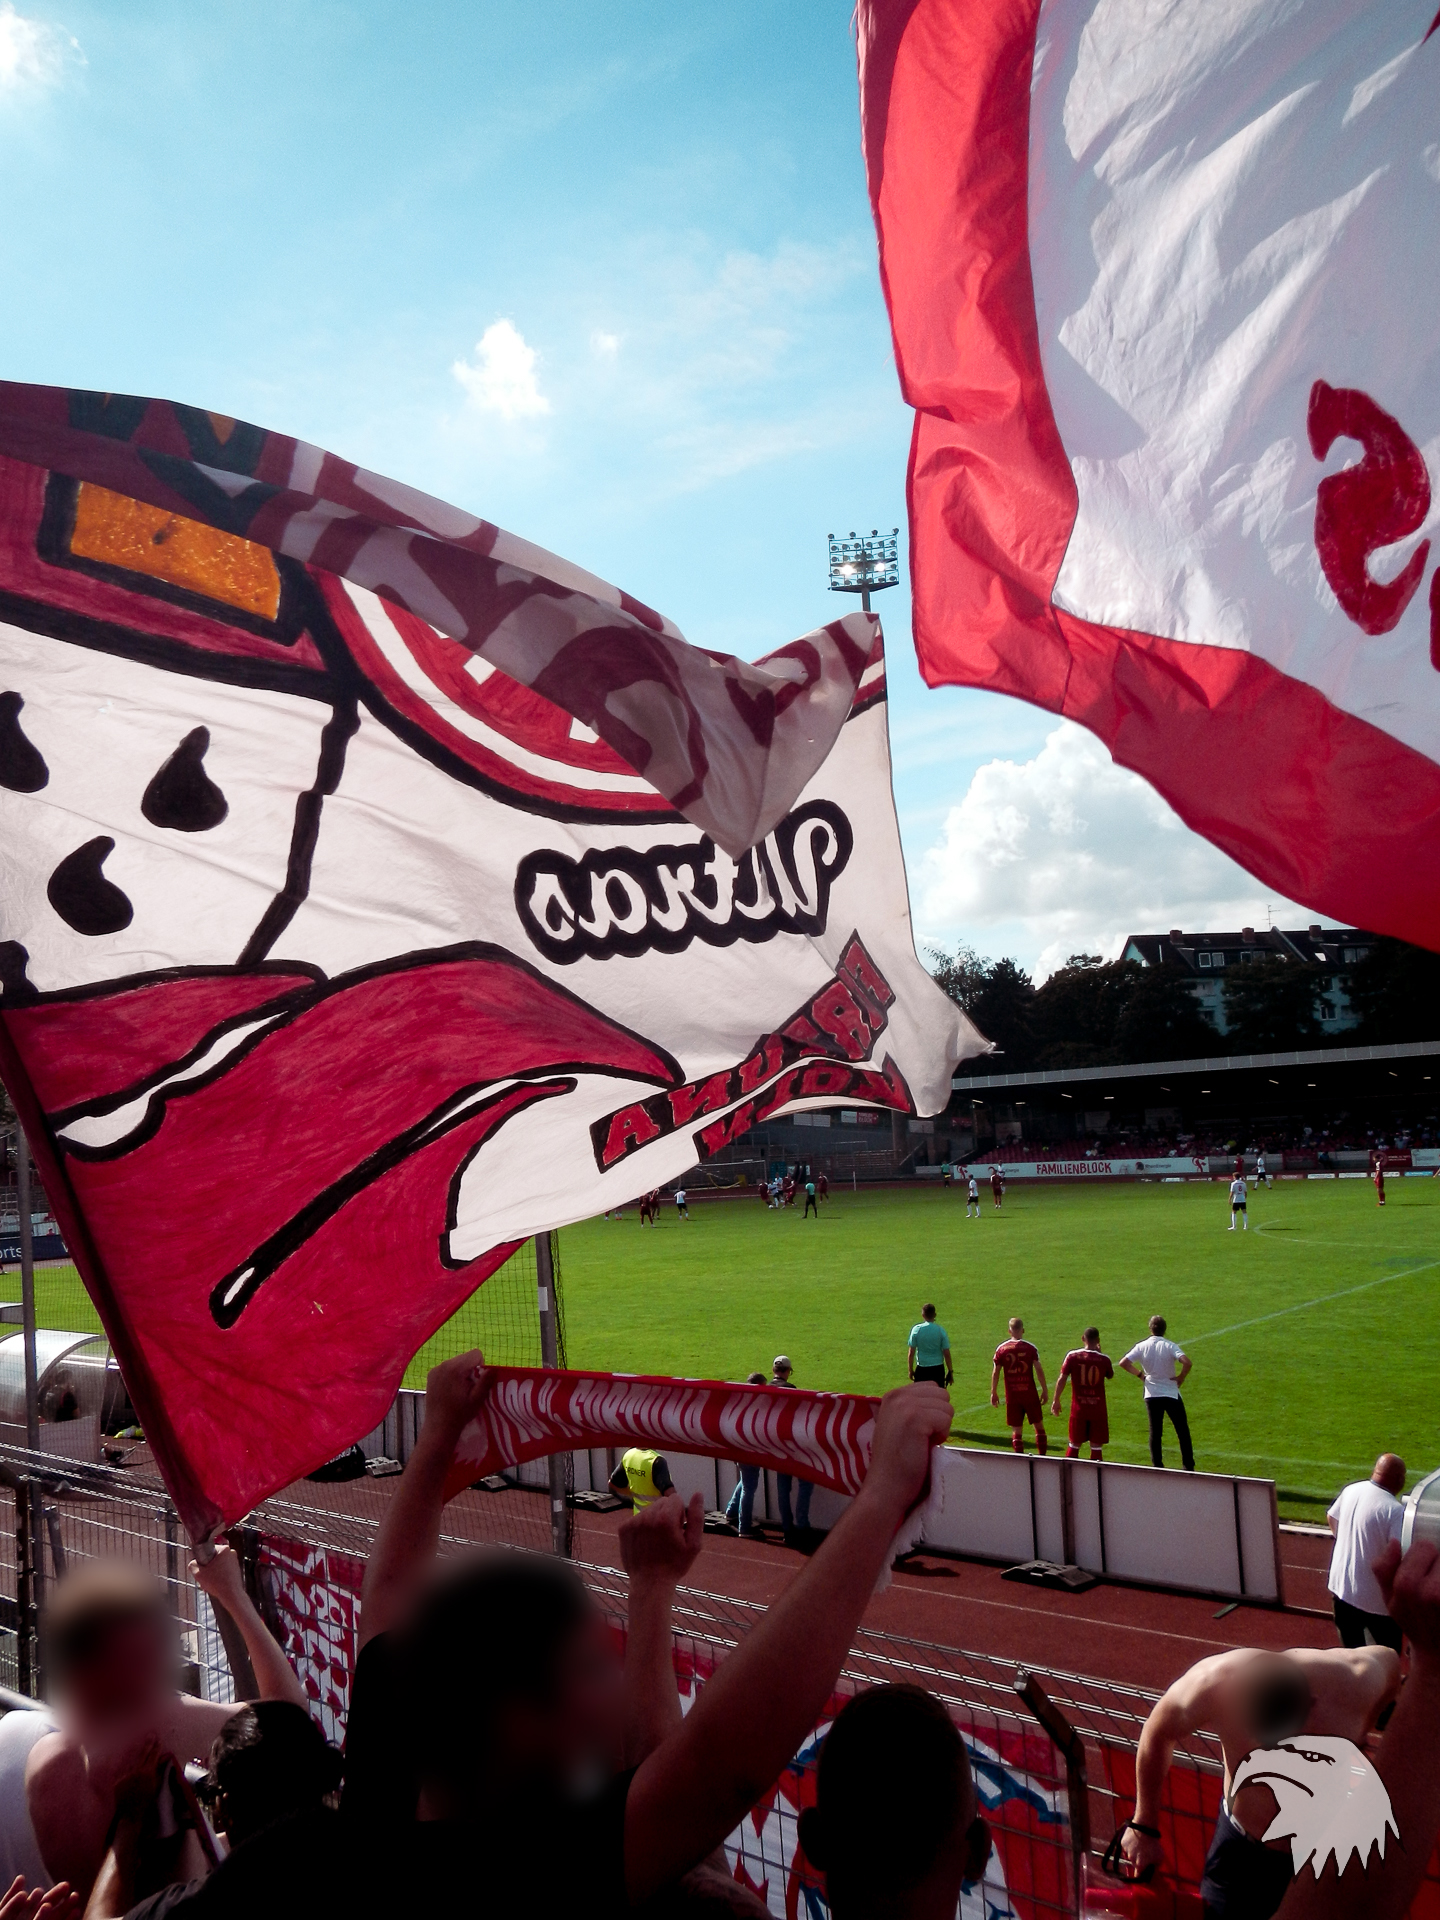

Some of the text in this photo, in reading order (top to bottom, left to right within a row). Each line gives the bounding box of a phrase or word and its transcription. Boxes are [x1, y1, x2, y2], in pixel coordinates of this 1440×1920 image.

[1036, 1161, 1112, 1175] FAMILIENBLOCK
[1005, 1352, 1029, 1374] 25
[1077, 1363, 1100, 1386] 10
[569, 1378, 729, 1449] FORTUNA
[626, 1466, 646, 1478] RDNER
